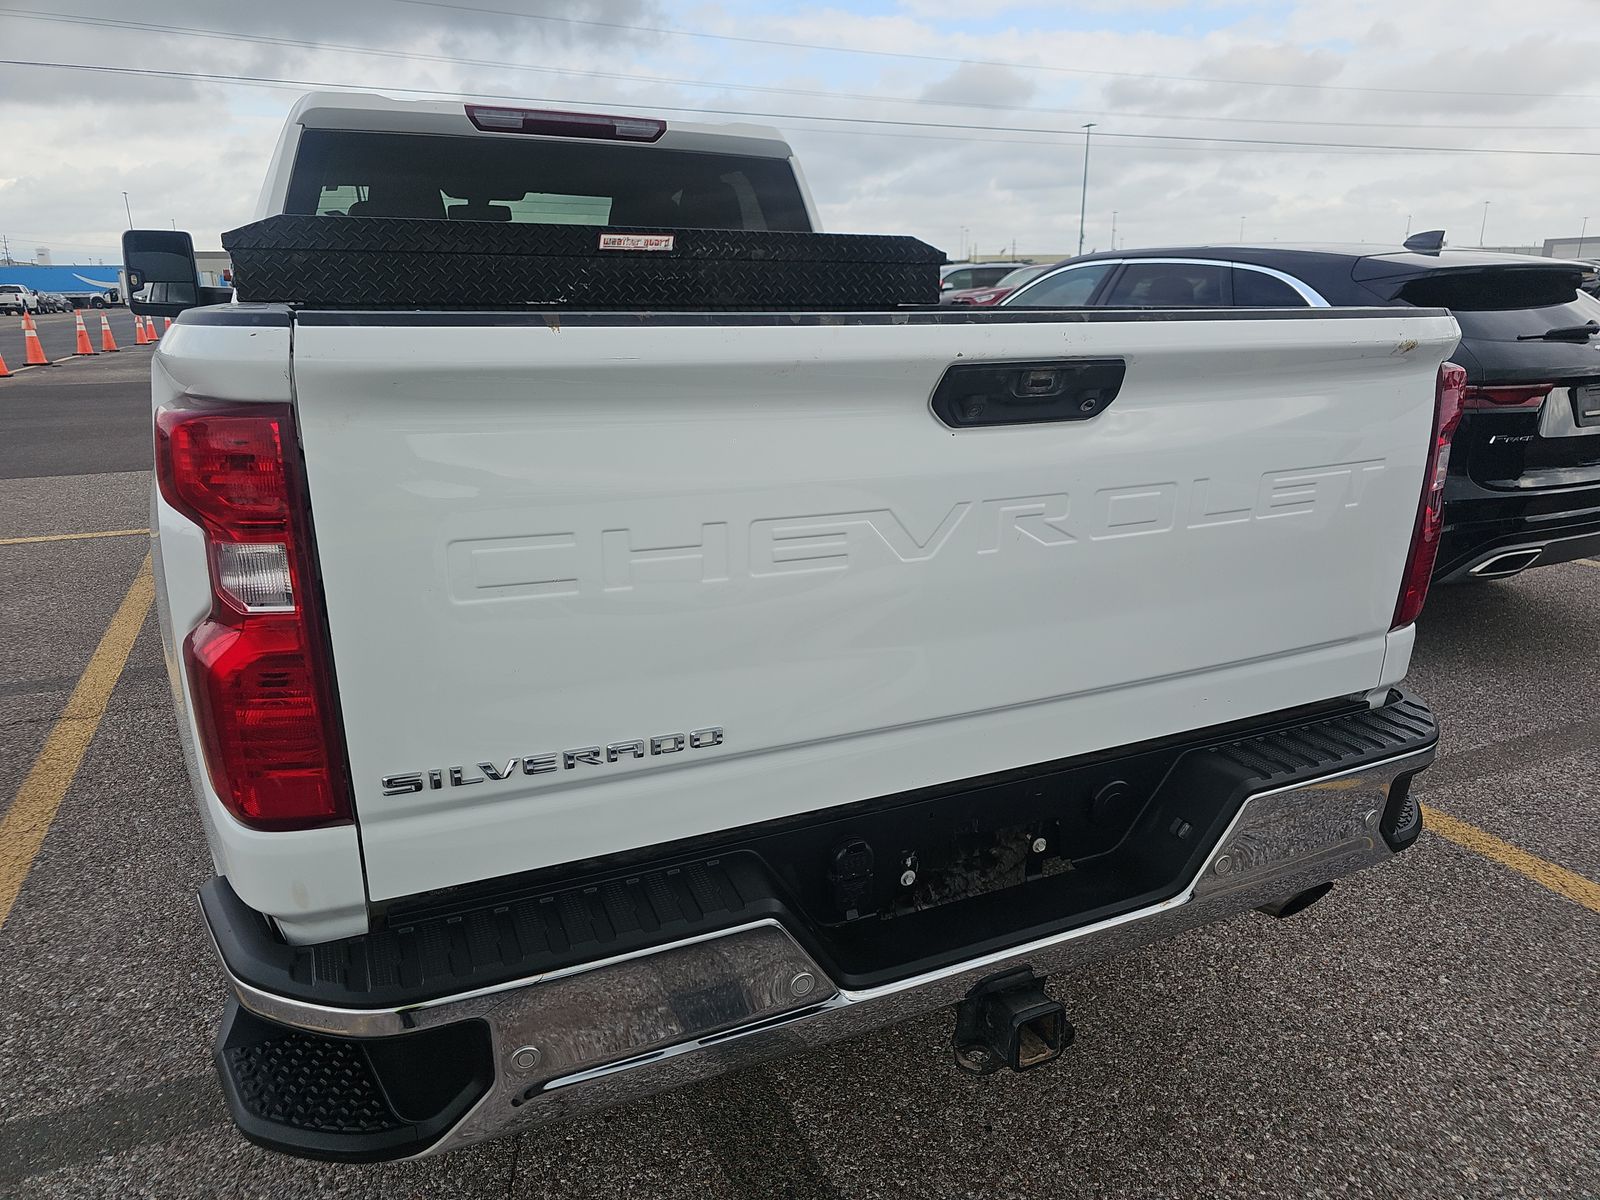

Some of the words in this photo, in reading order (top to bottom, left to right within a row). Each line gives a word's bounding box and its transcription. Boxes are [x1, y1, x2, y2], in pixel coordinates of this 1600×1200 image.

[643, 238, 670, 247] guard
[446, 457, 1386, 605] CHEVROLET
[382, 726, 723, 797] SILVERADO
